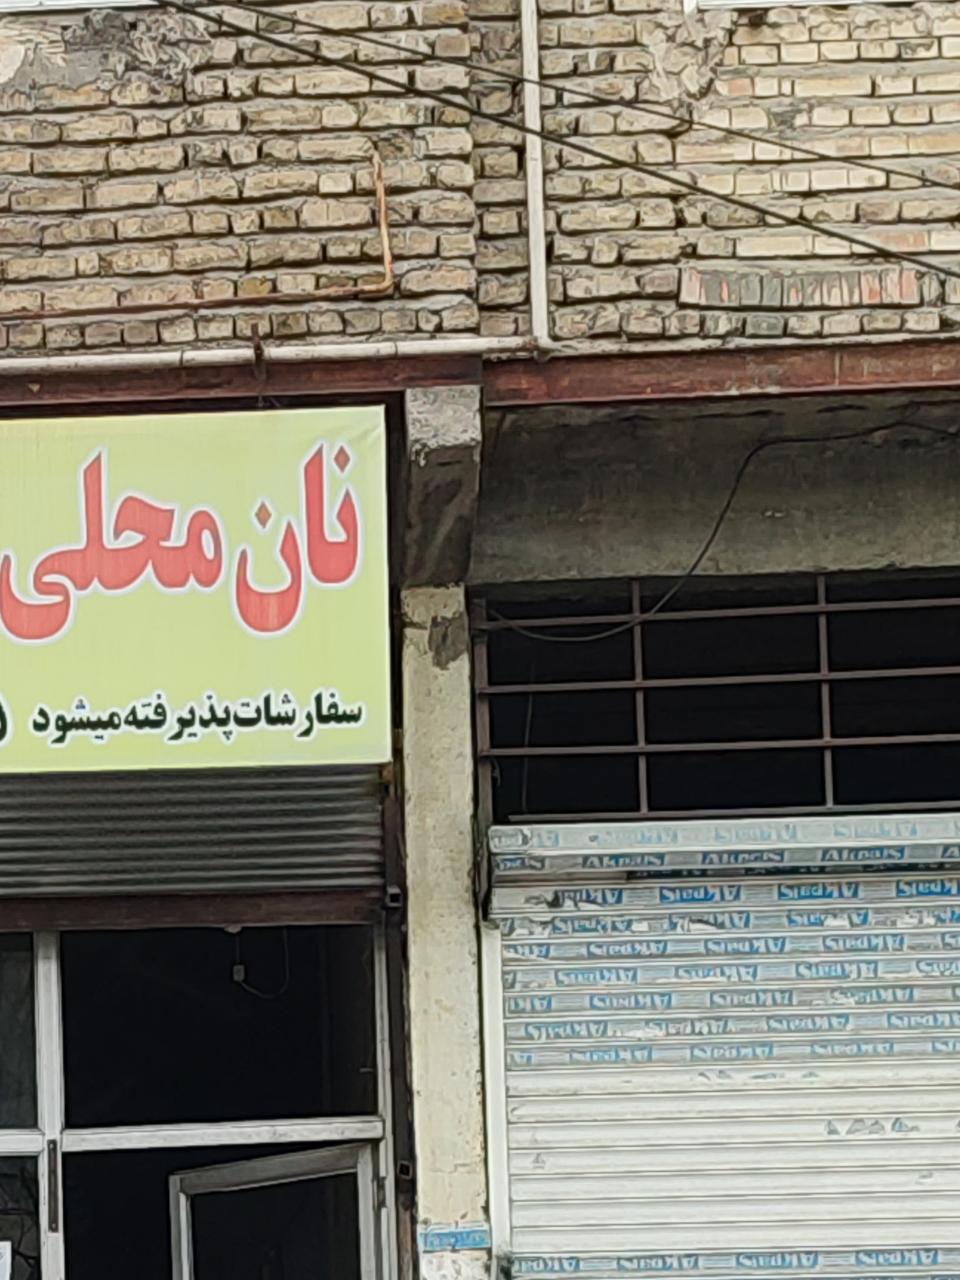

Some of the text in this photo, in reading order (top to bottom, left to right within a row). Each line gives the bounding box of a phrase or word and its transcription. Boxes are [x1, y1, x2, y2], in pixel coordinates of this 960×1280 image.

[0, 448, 222, 641] محلی
[237, 447, 358, 632] نان
[33, 700, 121, 744] میشود
[124, 694, 232, 740] پذیرفته
[233, 693, 362, 737] سفارشات
